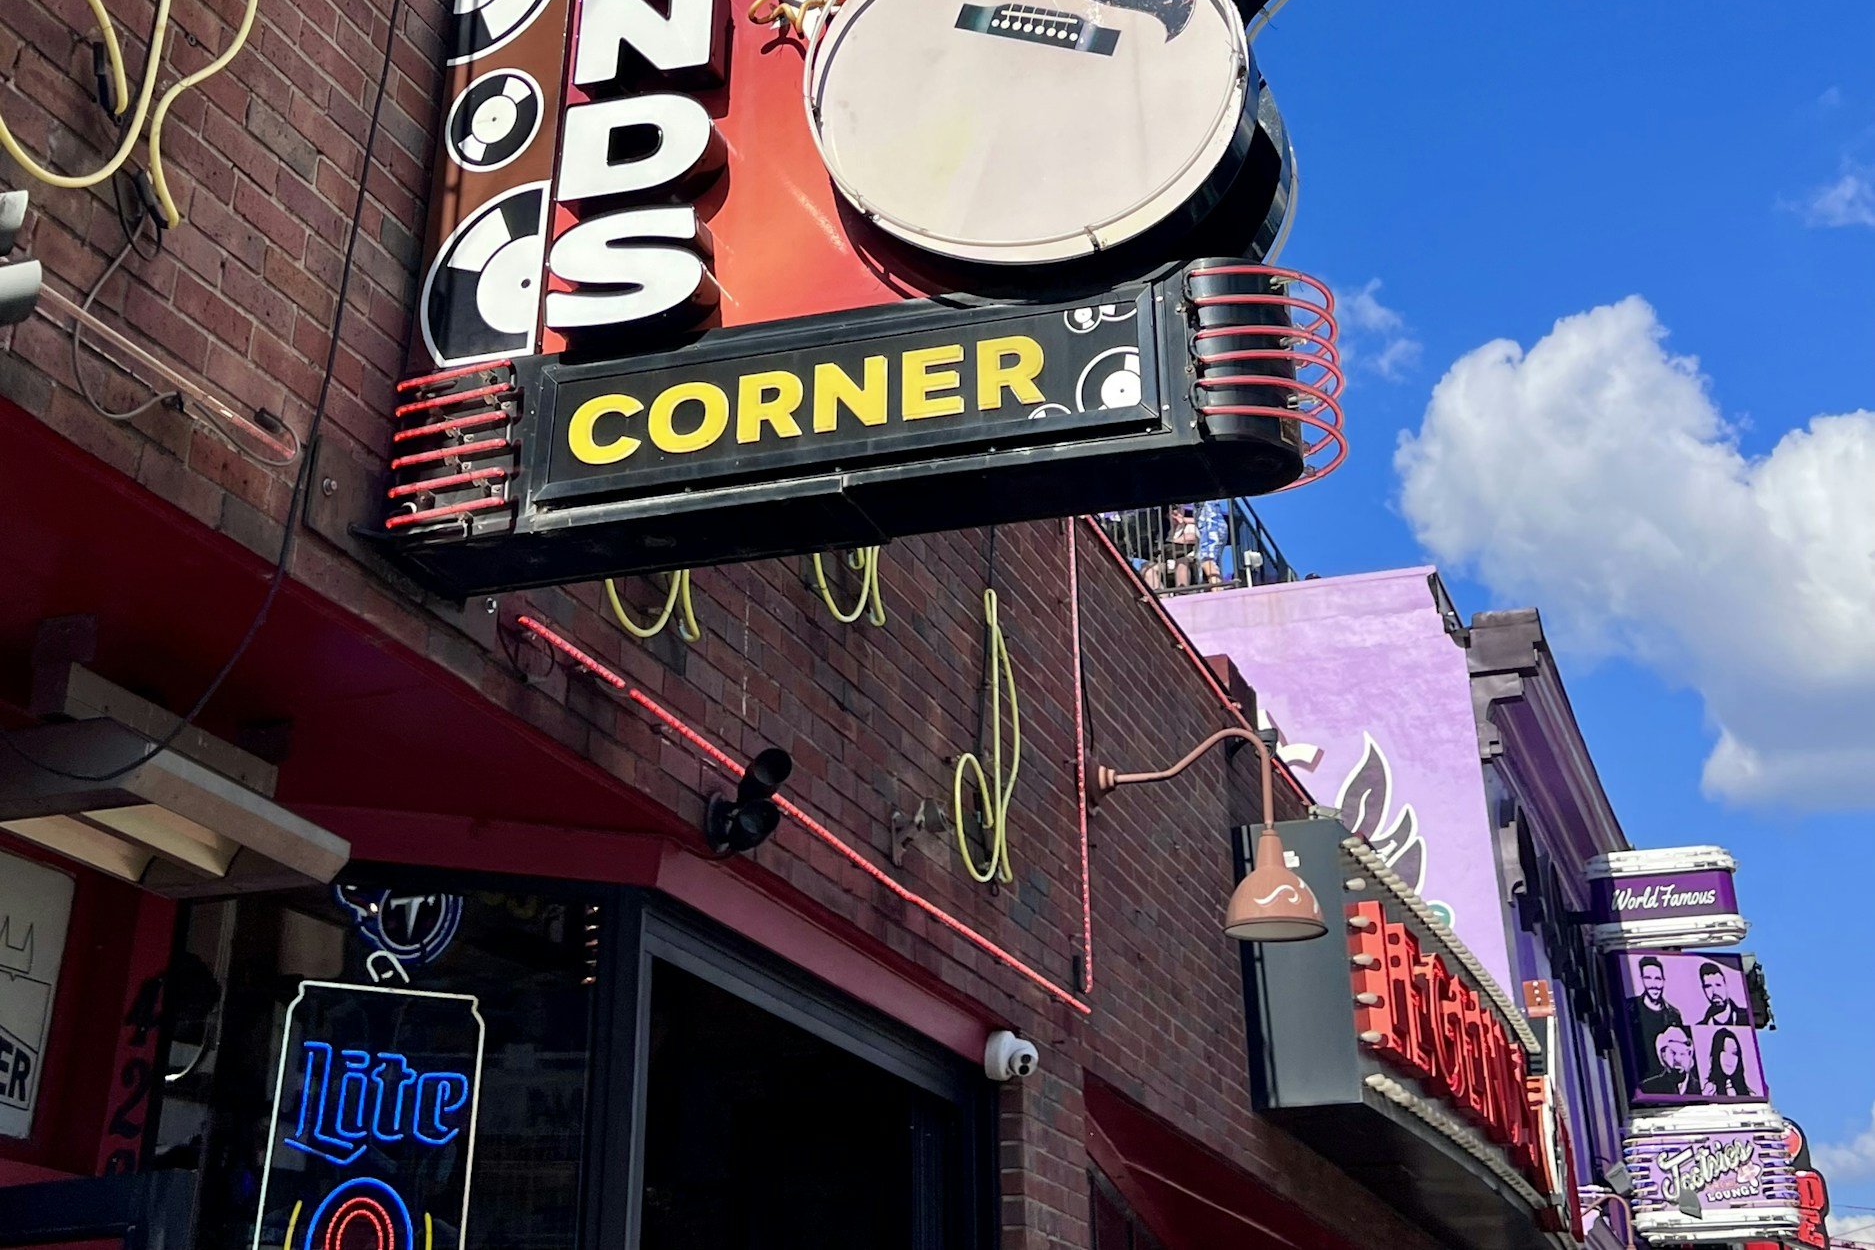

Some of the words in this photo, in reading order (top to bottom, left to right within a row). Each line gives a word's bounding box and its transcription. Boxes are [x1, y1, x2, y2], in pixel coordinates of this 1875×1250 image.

[567, 335, 1047, 465] CORNER
[1611, 885, 1659, 911] World
[1660, 883, 1716, 907] Famous
[285, 1041, 469, 1164] Lite
[1706, 1185, 1759, 1202] LOUNGE
